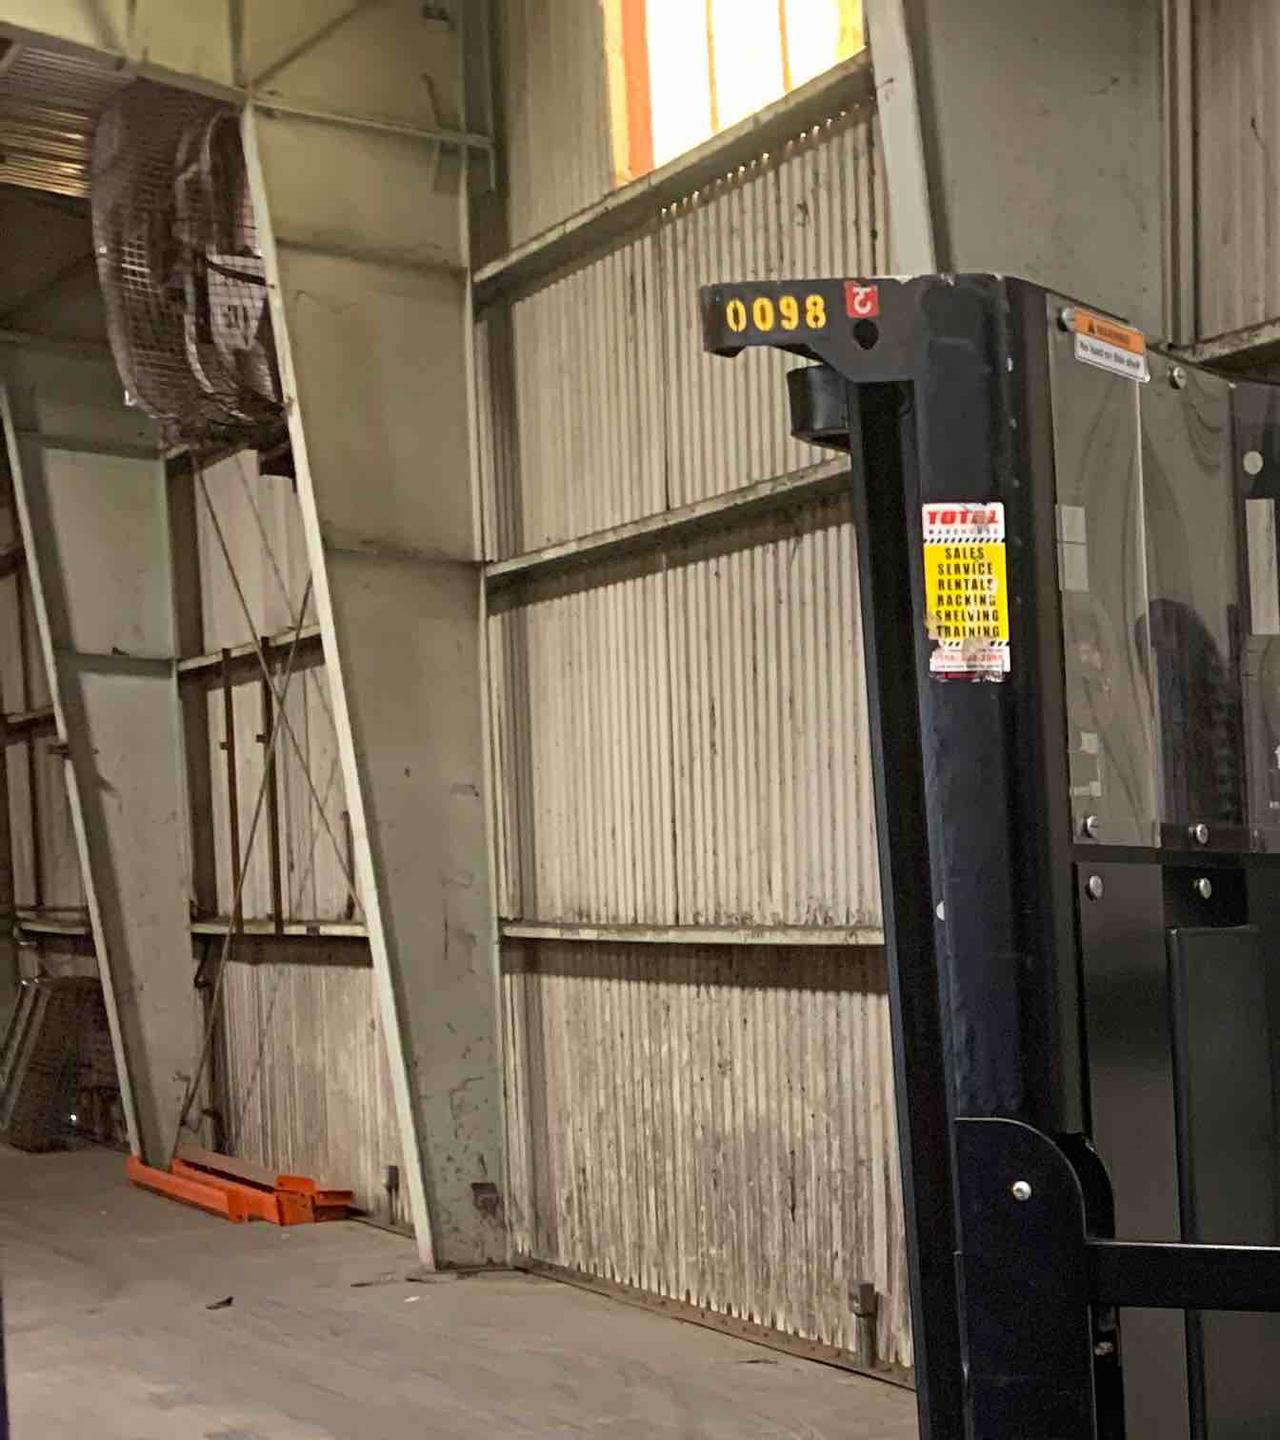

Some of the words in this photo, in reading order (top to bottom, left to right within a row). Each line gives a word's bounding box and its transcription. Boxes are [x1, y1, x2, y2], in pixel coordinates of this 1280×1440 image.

[726, 294, 827, 333] 0098
[928, 510, 999, 525] TOTAL
[945, 547, 985, 560] SALES
[938, 563, 993, 576] SERVICE
[938, 578, 994, 591] RENTALS
[937, 594, 996, 607] RACKING
[935, 609, 999, 622] SHELVING
[935, 625, 1000, 638] TRAINING
